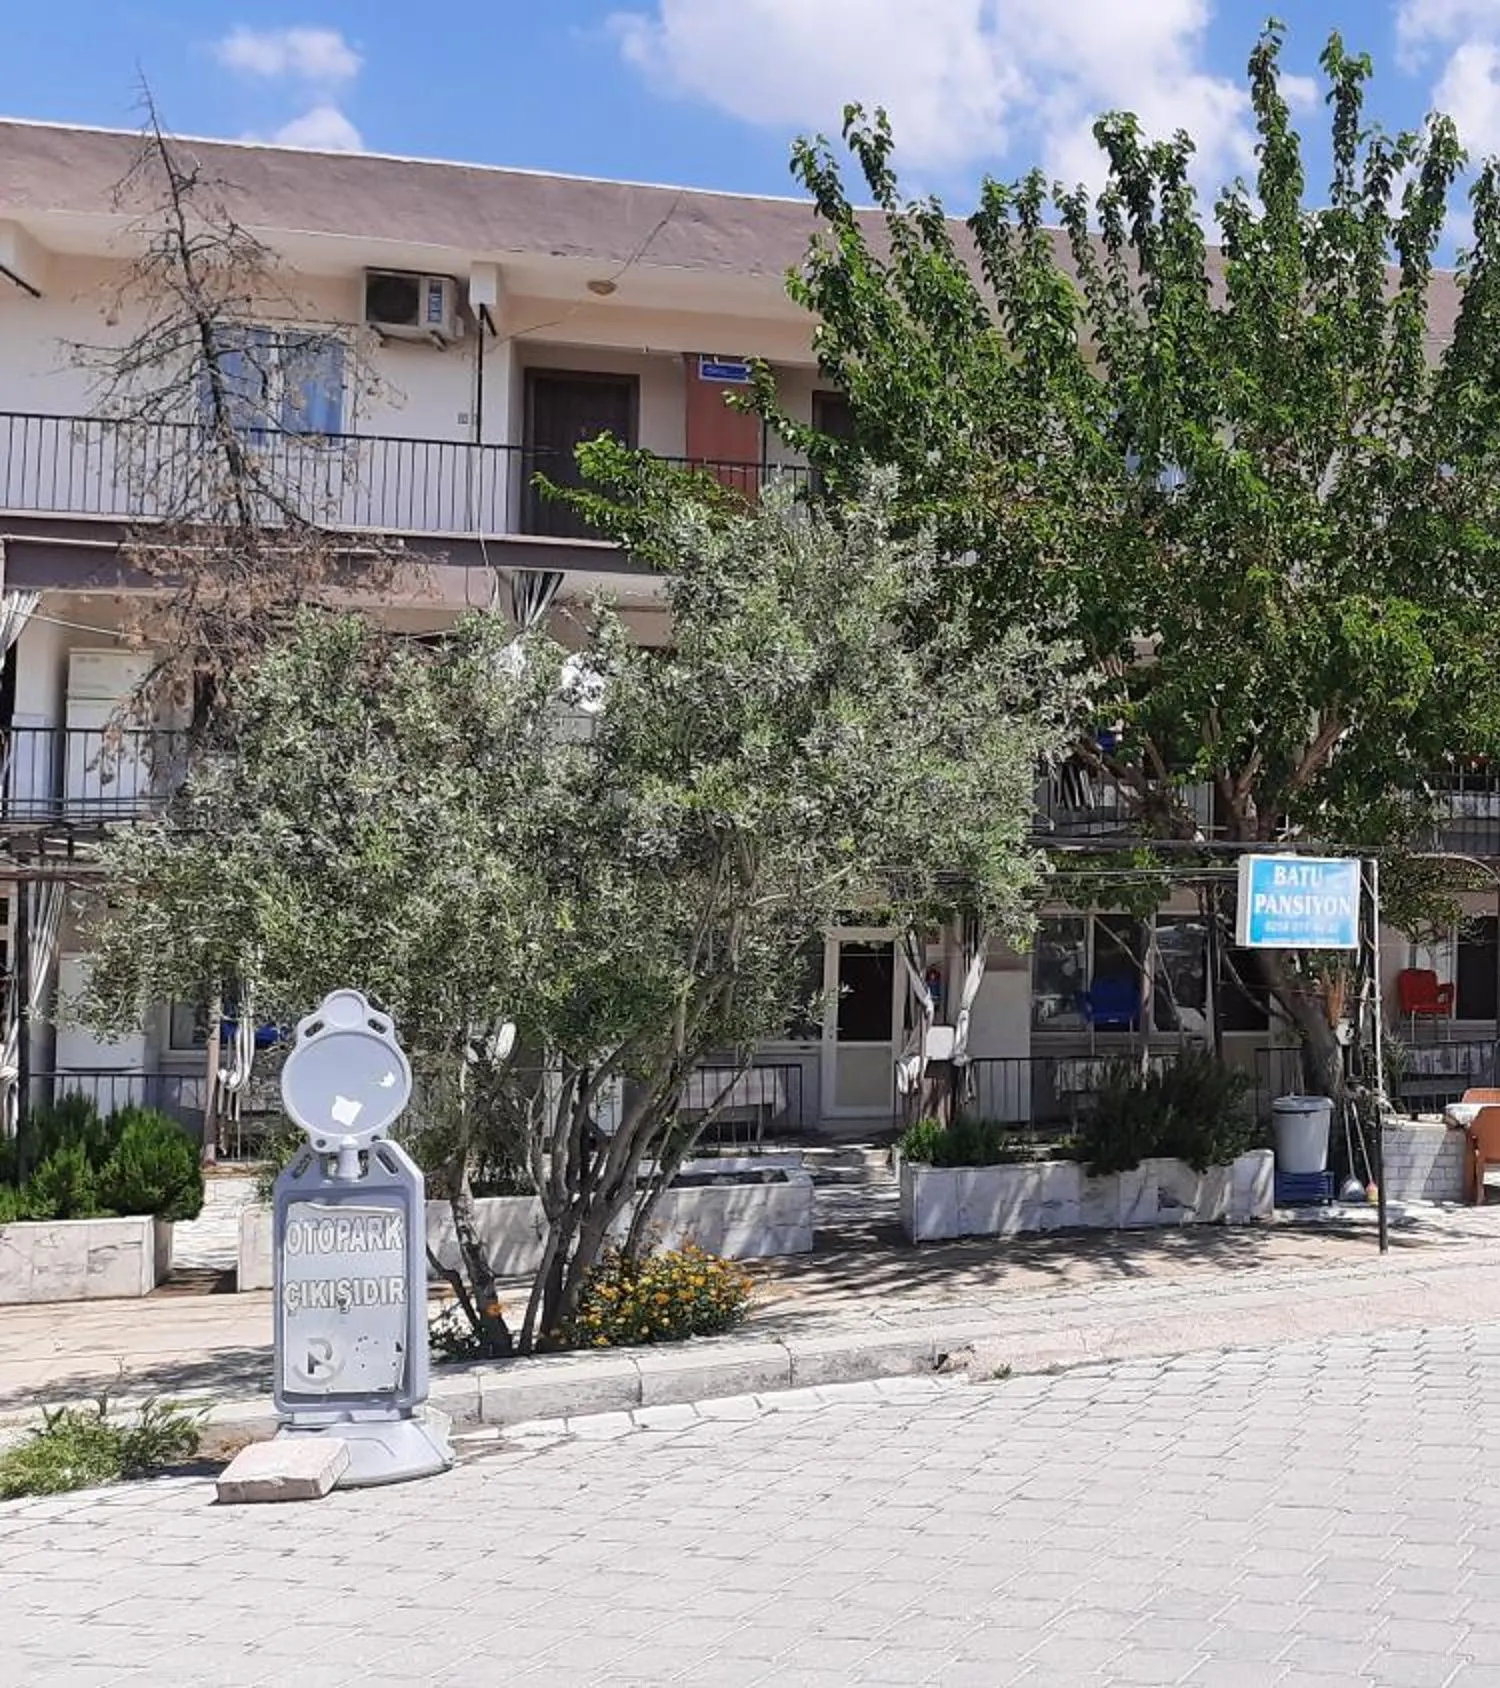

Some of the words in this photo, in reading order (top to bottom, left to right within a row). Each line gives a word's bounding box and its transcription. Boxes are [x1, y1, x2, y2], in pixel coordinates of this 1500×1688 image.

[1273, 865, 1324, 886] BATU
[287, 1215, 404, 1256] OTOPARK
[284, 1276, 407, 1317] ÇIKIŞIDIR
